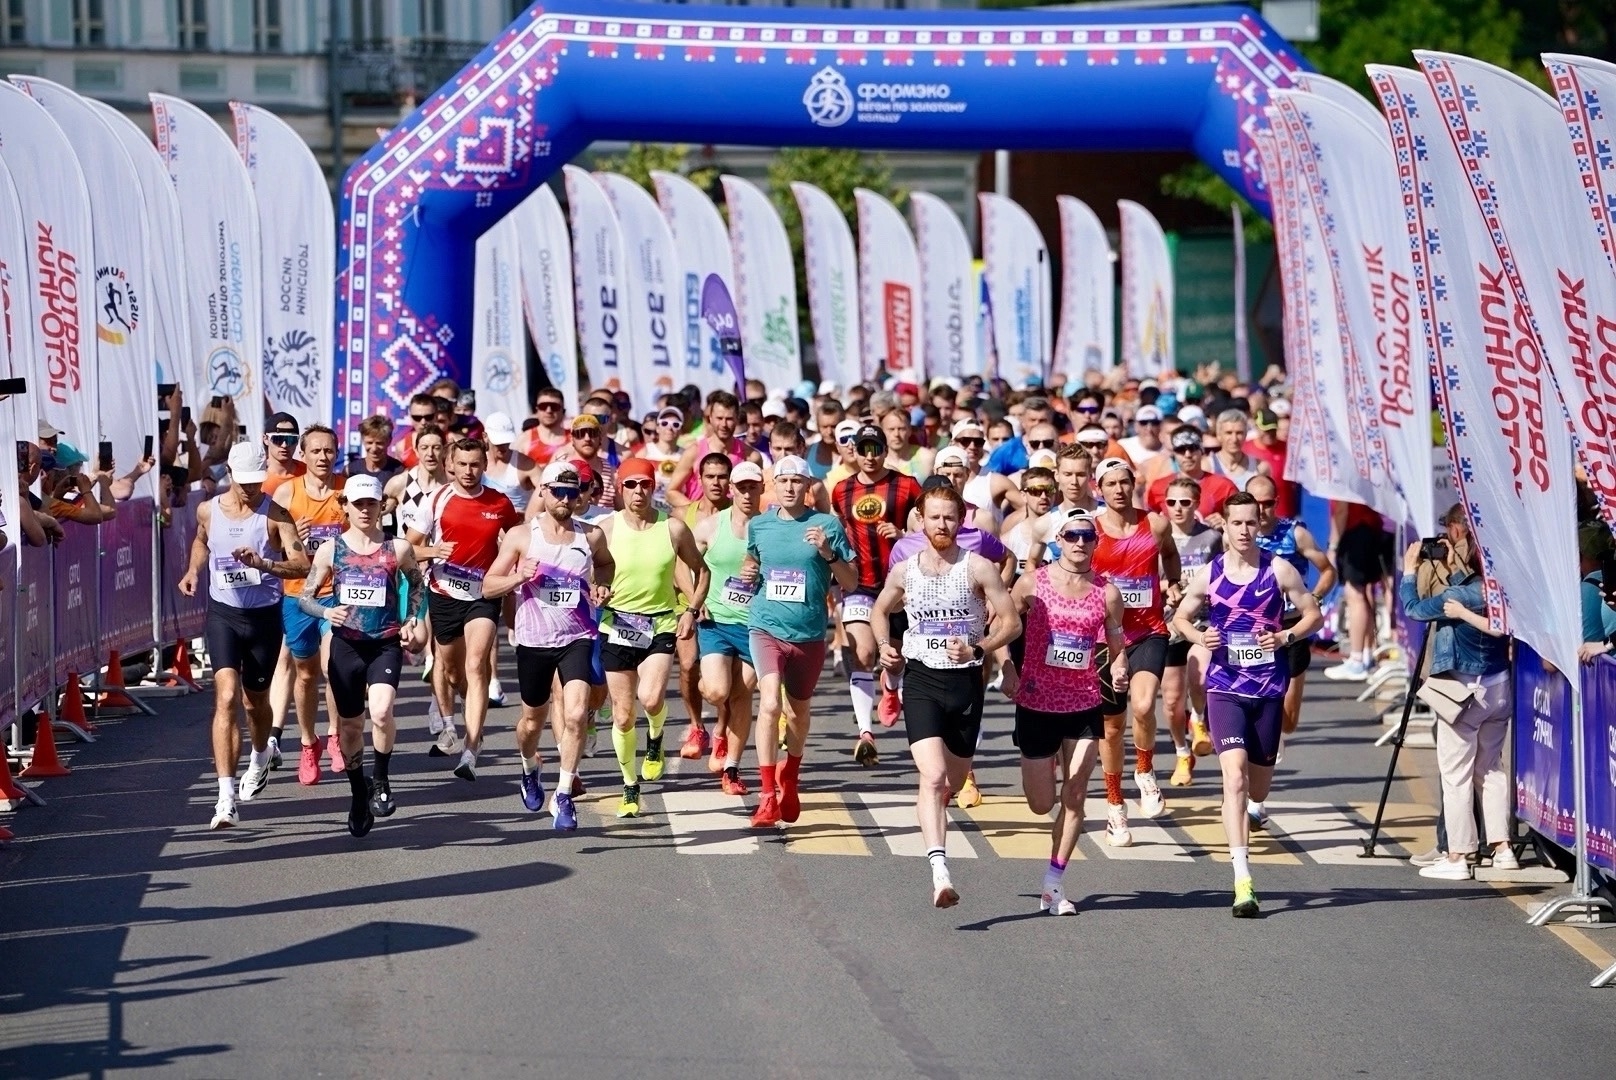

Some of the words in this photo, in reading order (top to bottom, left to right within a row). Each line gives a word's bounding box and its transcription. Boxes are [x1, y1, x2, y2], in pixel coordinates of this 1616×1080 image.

[857, 83, 951, 102] фармэко
[857, 102, 891, 112] БЕГОМ
[892, 102, 908, 112] ПО
[909, 102, 968, 113] ЗОЛОТОМУ
[857, 113, 902, 124] КОЛЬЦУ
[308, 540, 329, 551] 10
[223, 571, 248, 584] 1341
[448, 577, 471, 592] 1168
[775, 585, 798, 596] 1177
[347, 588, 375, 600] 1357
[549, 591, 572, 603] 1517
[728, 591, 753, 604] 1267
[1122, 592, 1142, 603] 301
[849, 607, 869, 617] 1351
[617, 628, 643, 642] 1027
[1053, 649, 1084, 663] 1409
[1236, 648, 1263, 660] 1166
